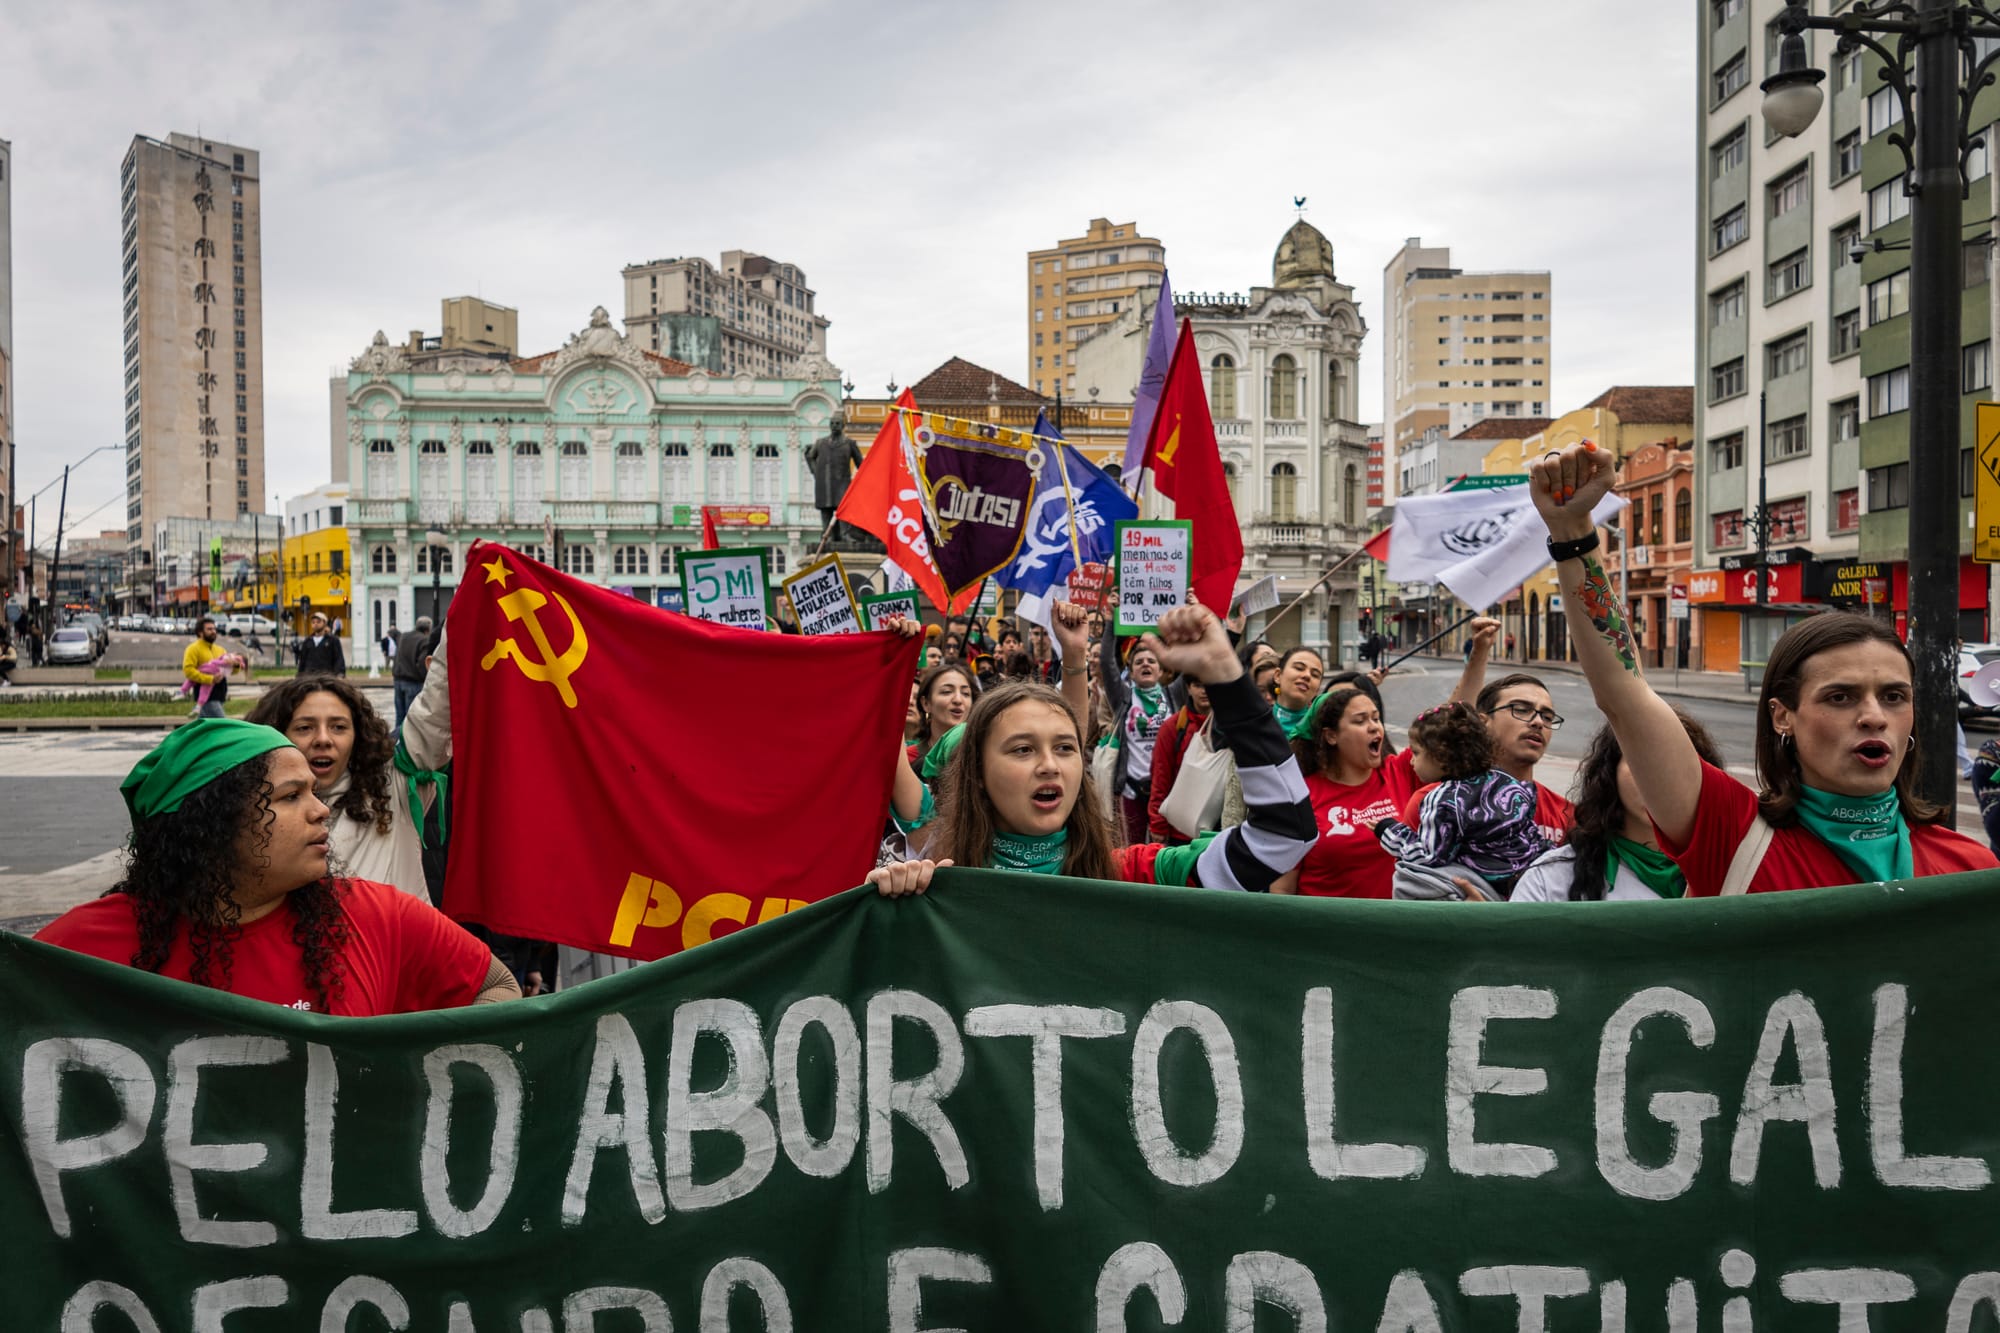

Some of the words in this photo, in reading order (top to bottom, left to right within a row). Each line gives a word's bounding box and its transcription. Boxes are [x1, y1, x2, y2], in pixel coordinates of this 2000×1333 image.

[1124, 530, 1142, 547] 19
[1143, 536, 1163, 547] MIL
[1123, 550, 1168, 561] meninas
[1171, 550, 1183, 560] de
[1155, 564, 1176, 574] anos
[1837, 564, 1878, 579] GALERIA
[692, 562, 720, 604] 5
[800, 575, 832, 602] ENTRE
[826, 565, 839, 585] 7
[1124, 576, 1145, 589] têm
[1149, 577, 1173, 590] filhos
[1830, 581, 1862, 597] ANDR
[796, 586, 846, 620] MULHERES
[1123, 592, 1144, 605] POR
[1152, 593, 1177, 606] ANO
[719, 604, 762, 624] mulheres
[803, 605, 855, 636] ABORTARAM
[1122, 611, 1136, 622] no
[1352, 804, 1396, 821] Mulheres
[22, 1034, 522, 1247] PELO
[561, 988, 1244, 1228] ABORTO
[1302, 983, 1992, 1200] LEGAL
